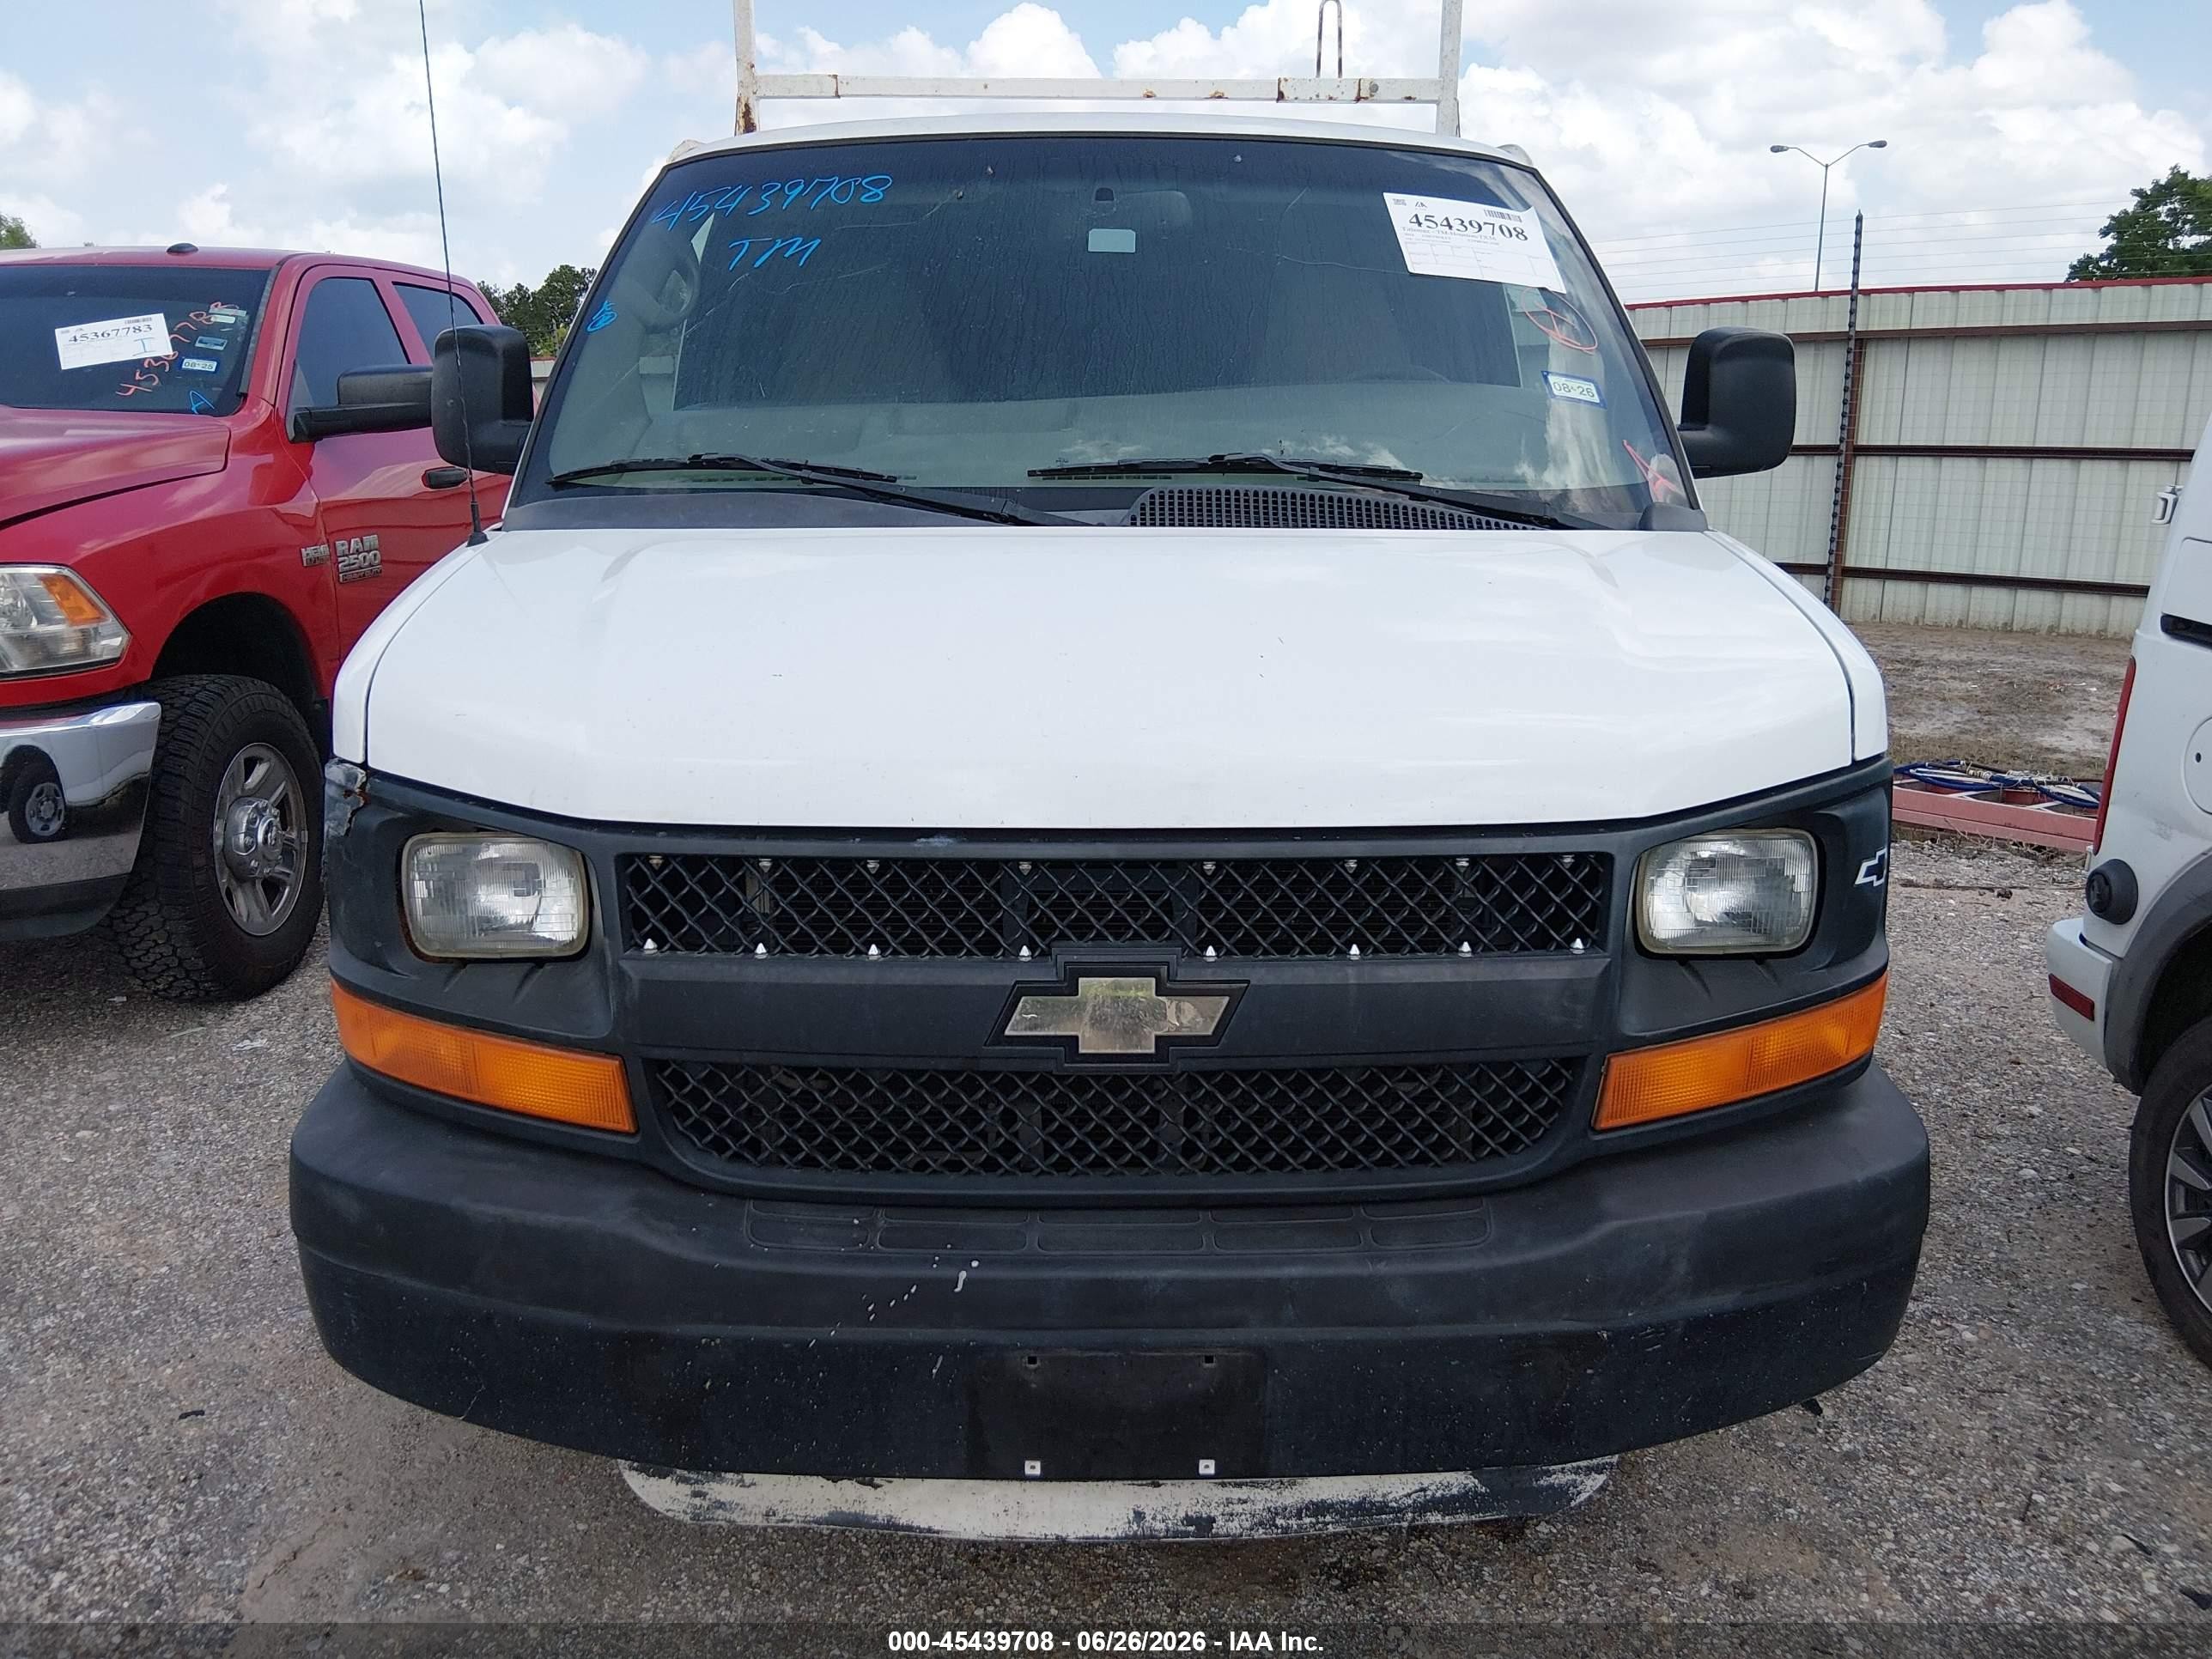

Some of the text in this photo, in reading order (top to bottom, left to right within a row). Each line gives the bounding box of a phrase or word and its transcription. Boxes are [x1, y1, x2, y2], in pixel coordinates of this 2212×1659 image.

[651, 174, 893, 232] 45439708
[1408, 213, 1529, 241] 45439708
[729, 236, 822, 271] TM
[68, 324, 153, 343] 45367783
[335, 534, 379, 556] RAM
[337, 550, 382, 573] 2500
